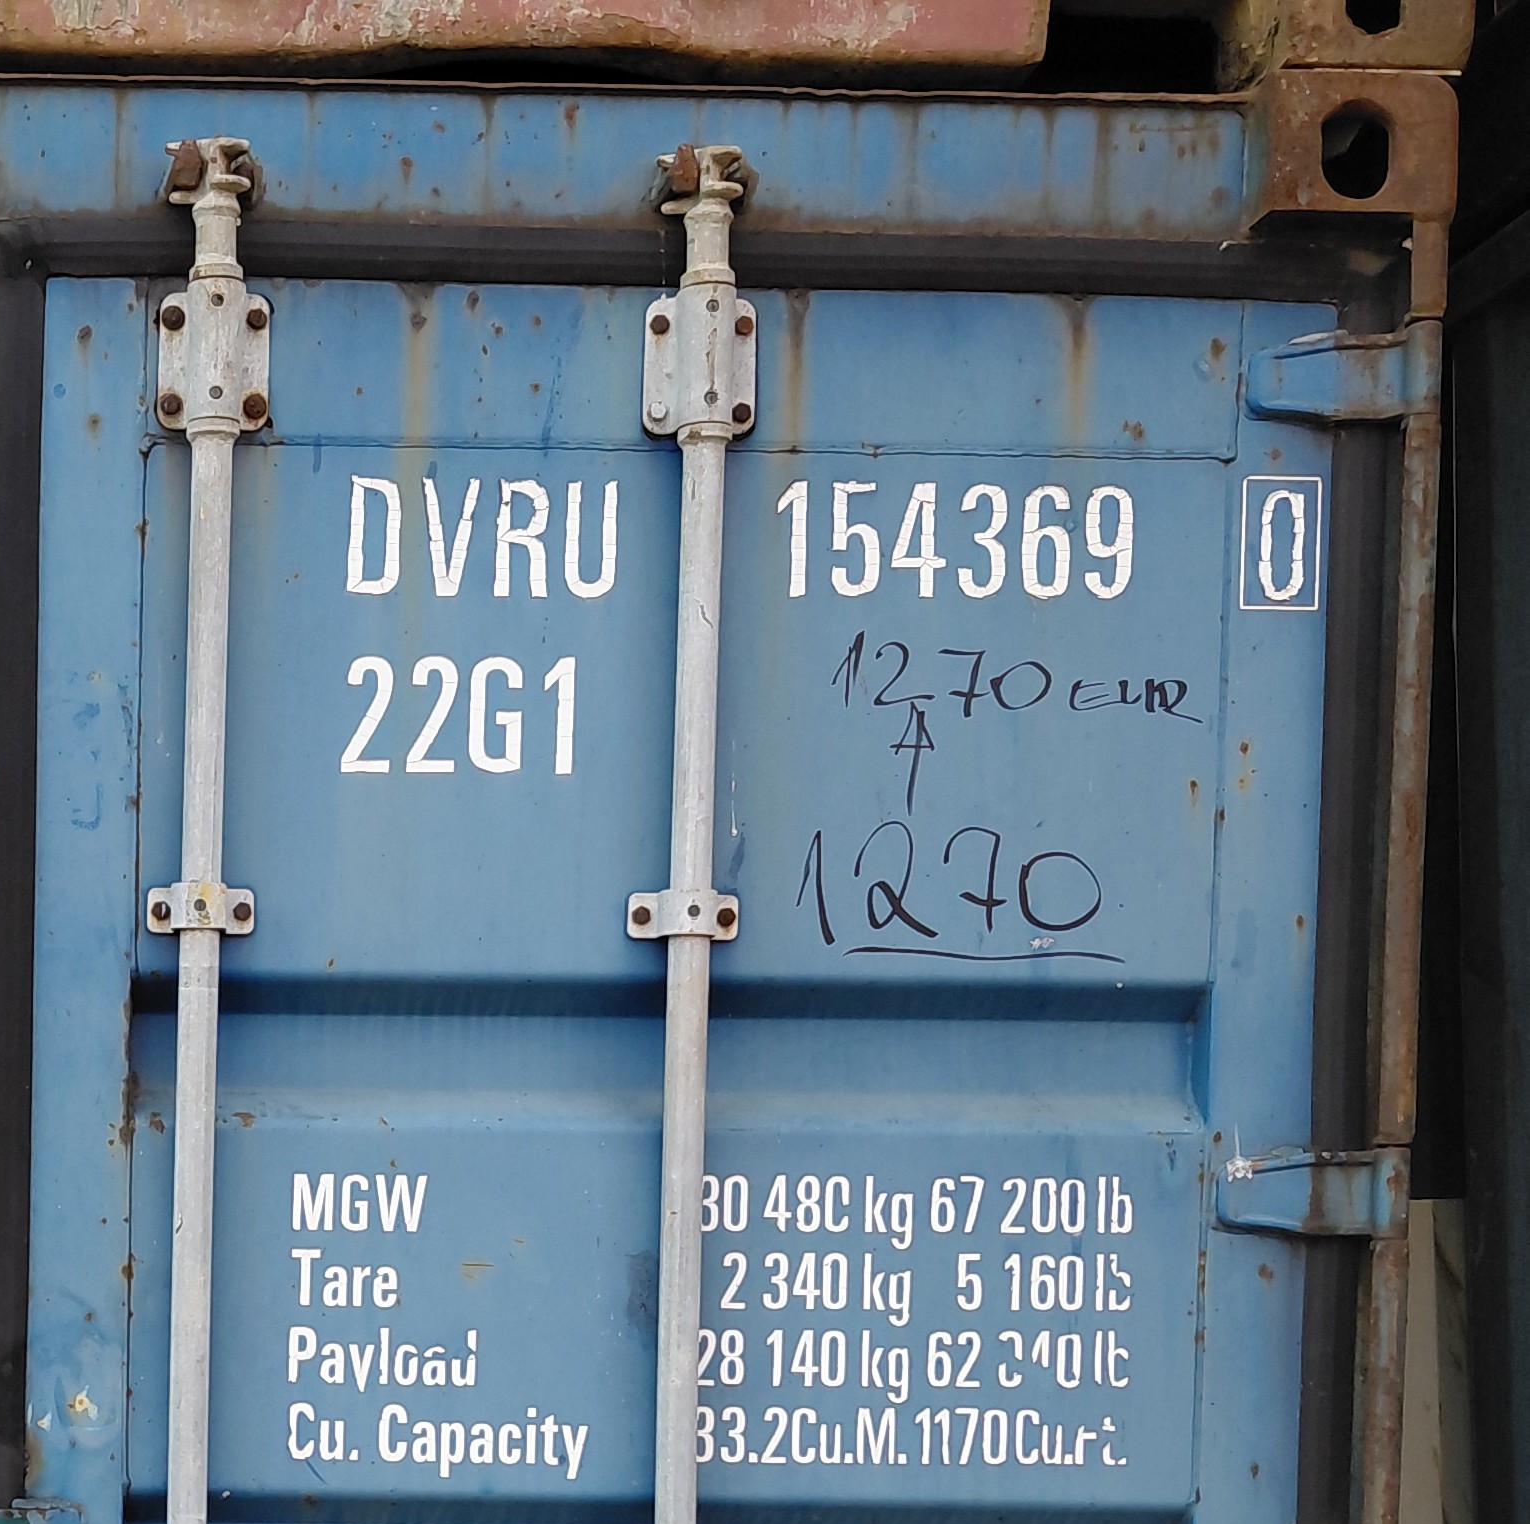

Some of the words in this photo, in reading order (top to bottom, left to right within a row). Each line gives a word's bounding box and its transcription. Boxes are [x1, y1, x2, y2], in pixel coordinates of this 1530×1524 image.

[346, 475, 618, 598] DVRU
[775, 480, 1133, 600] 154369
[1258, 490, 1305, 601] 0
[340, 655, 576, 774] 22G1
[831, 630, 1053, 718] 1270
[797, 820, 1102, 946] 1270
[291, 1173, 428, 1232] MGW
[701, 1175, 749, 1232] 30
[763, 1175, 850, 1232] 480
[864, 1175, 914, 1249] kg
[931, 1176, 985, 1233] 67
[1001, 1177, 1086, 1233] 200
[1097, 1176, 1133, 1234] lb
[291, 1249, 398, 1307] Tare
[720, 1252, 747, 1309] 2
[763, 1252, 849, 1309] 340
[863, 1252, 912, 1326] kg
[957, 1253, 982, 1310] 5
[1004, 1253, 1084, 1311] 160
[1095, 1253, 1131, 1311] lb
[287, 1326, 478, 1392] Payload
[697, 1329, 745, 1386] 28
[767, 1329, 847, 1387] 140
[861, 1329, 910, 1403] kg
[927, 1331, 981, 1388] 62
[1094, 1331, 1130, 1388] lb
[288, 1402, 359, 1461] Cu.
[378, 1403, 589, 1480] Capacity
